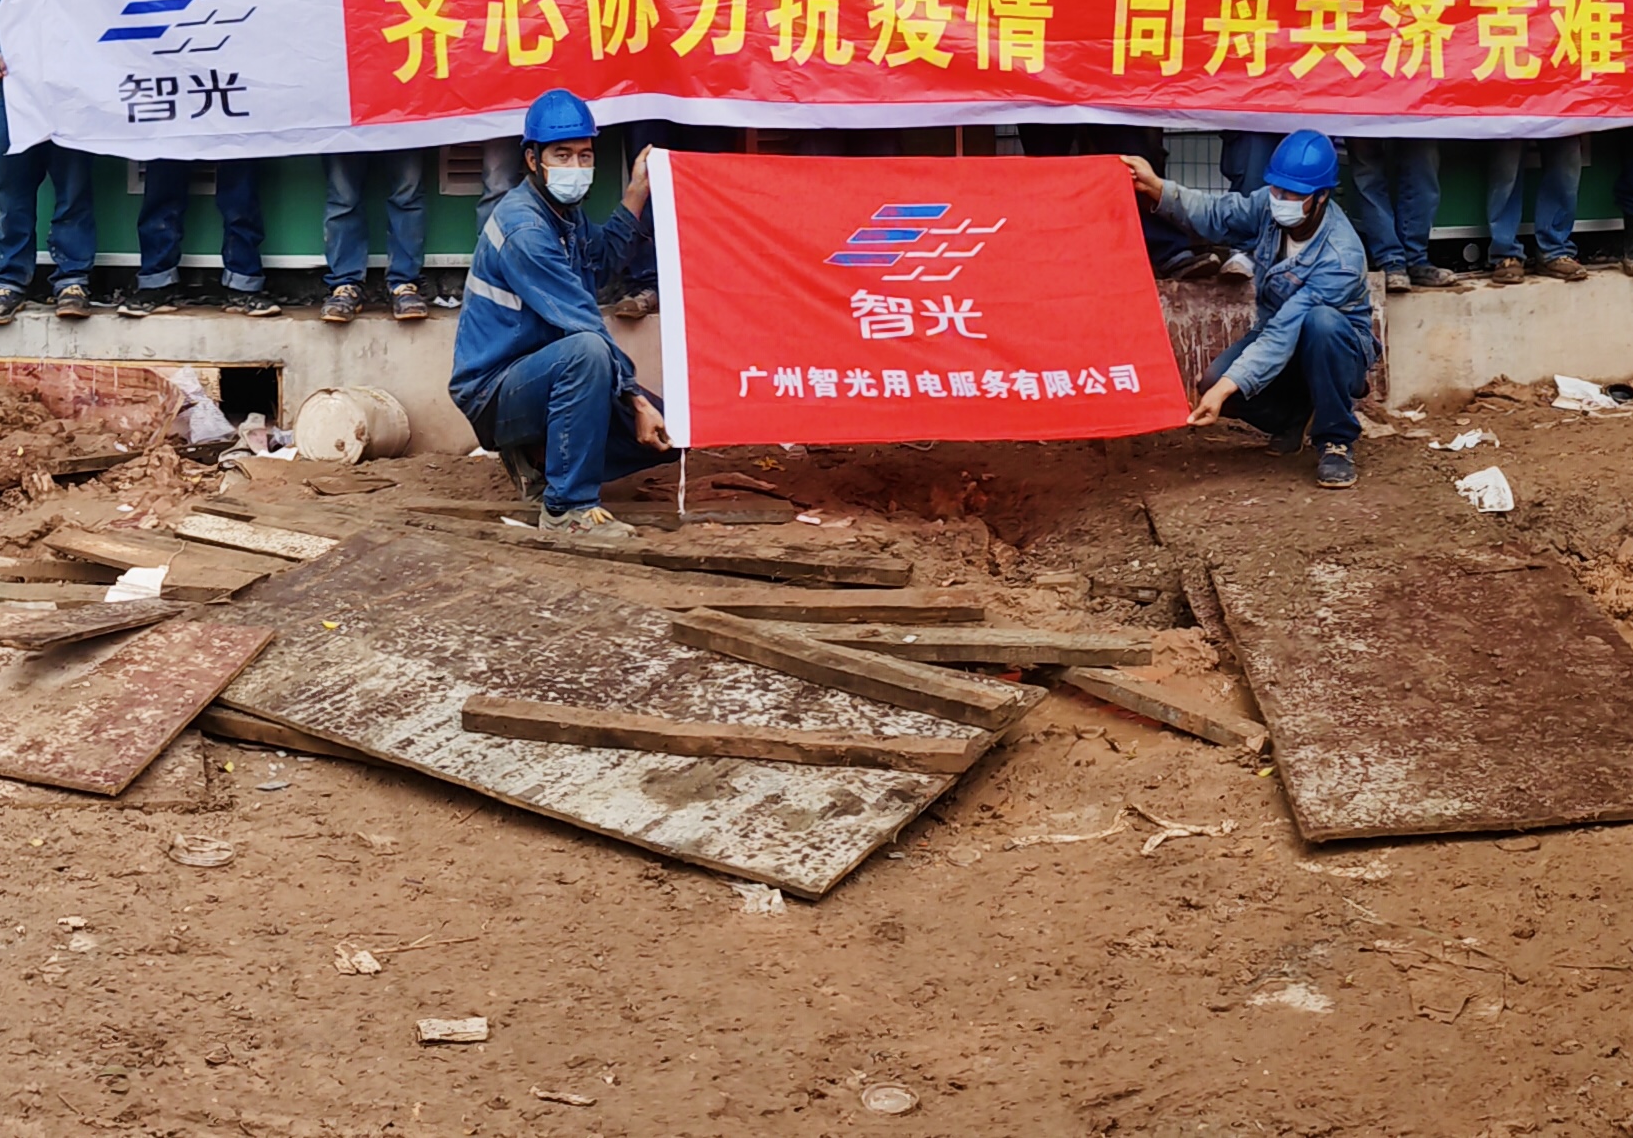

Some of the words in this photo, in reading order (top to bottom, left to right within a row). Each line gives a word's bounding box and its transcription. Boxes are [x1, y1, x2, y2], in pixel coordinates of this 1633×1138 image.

[118, 69, 251, 124] 智光
[850, 289, 988, 339] 智光
[739, 364, 1141, 401] 广州智光用电服务有限公司
